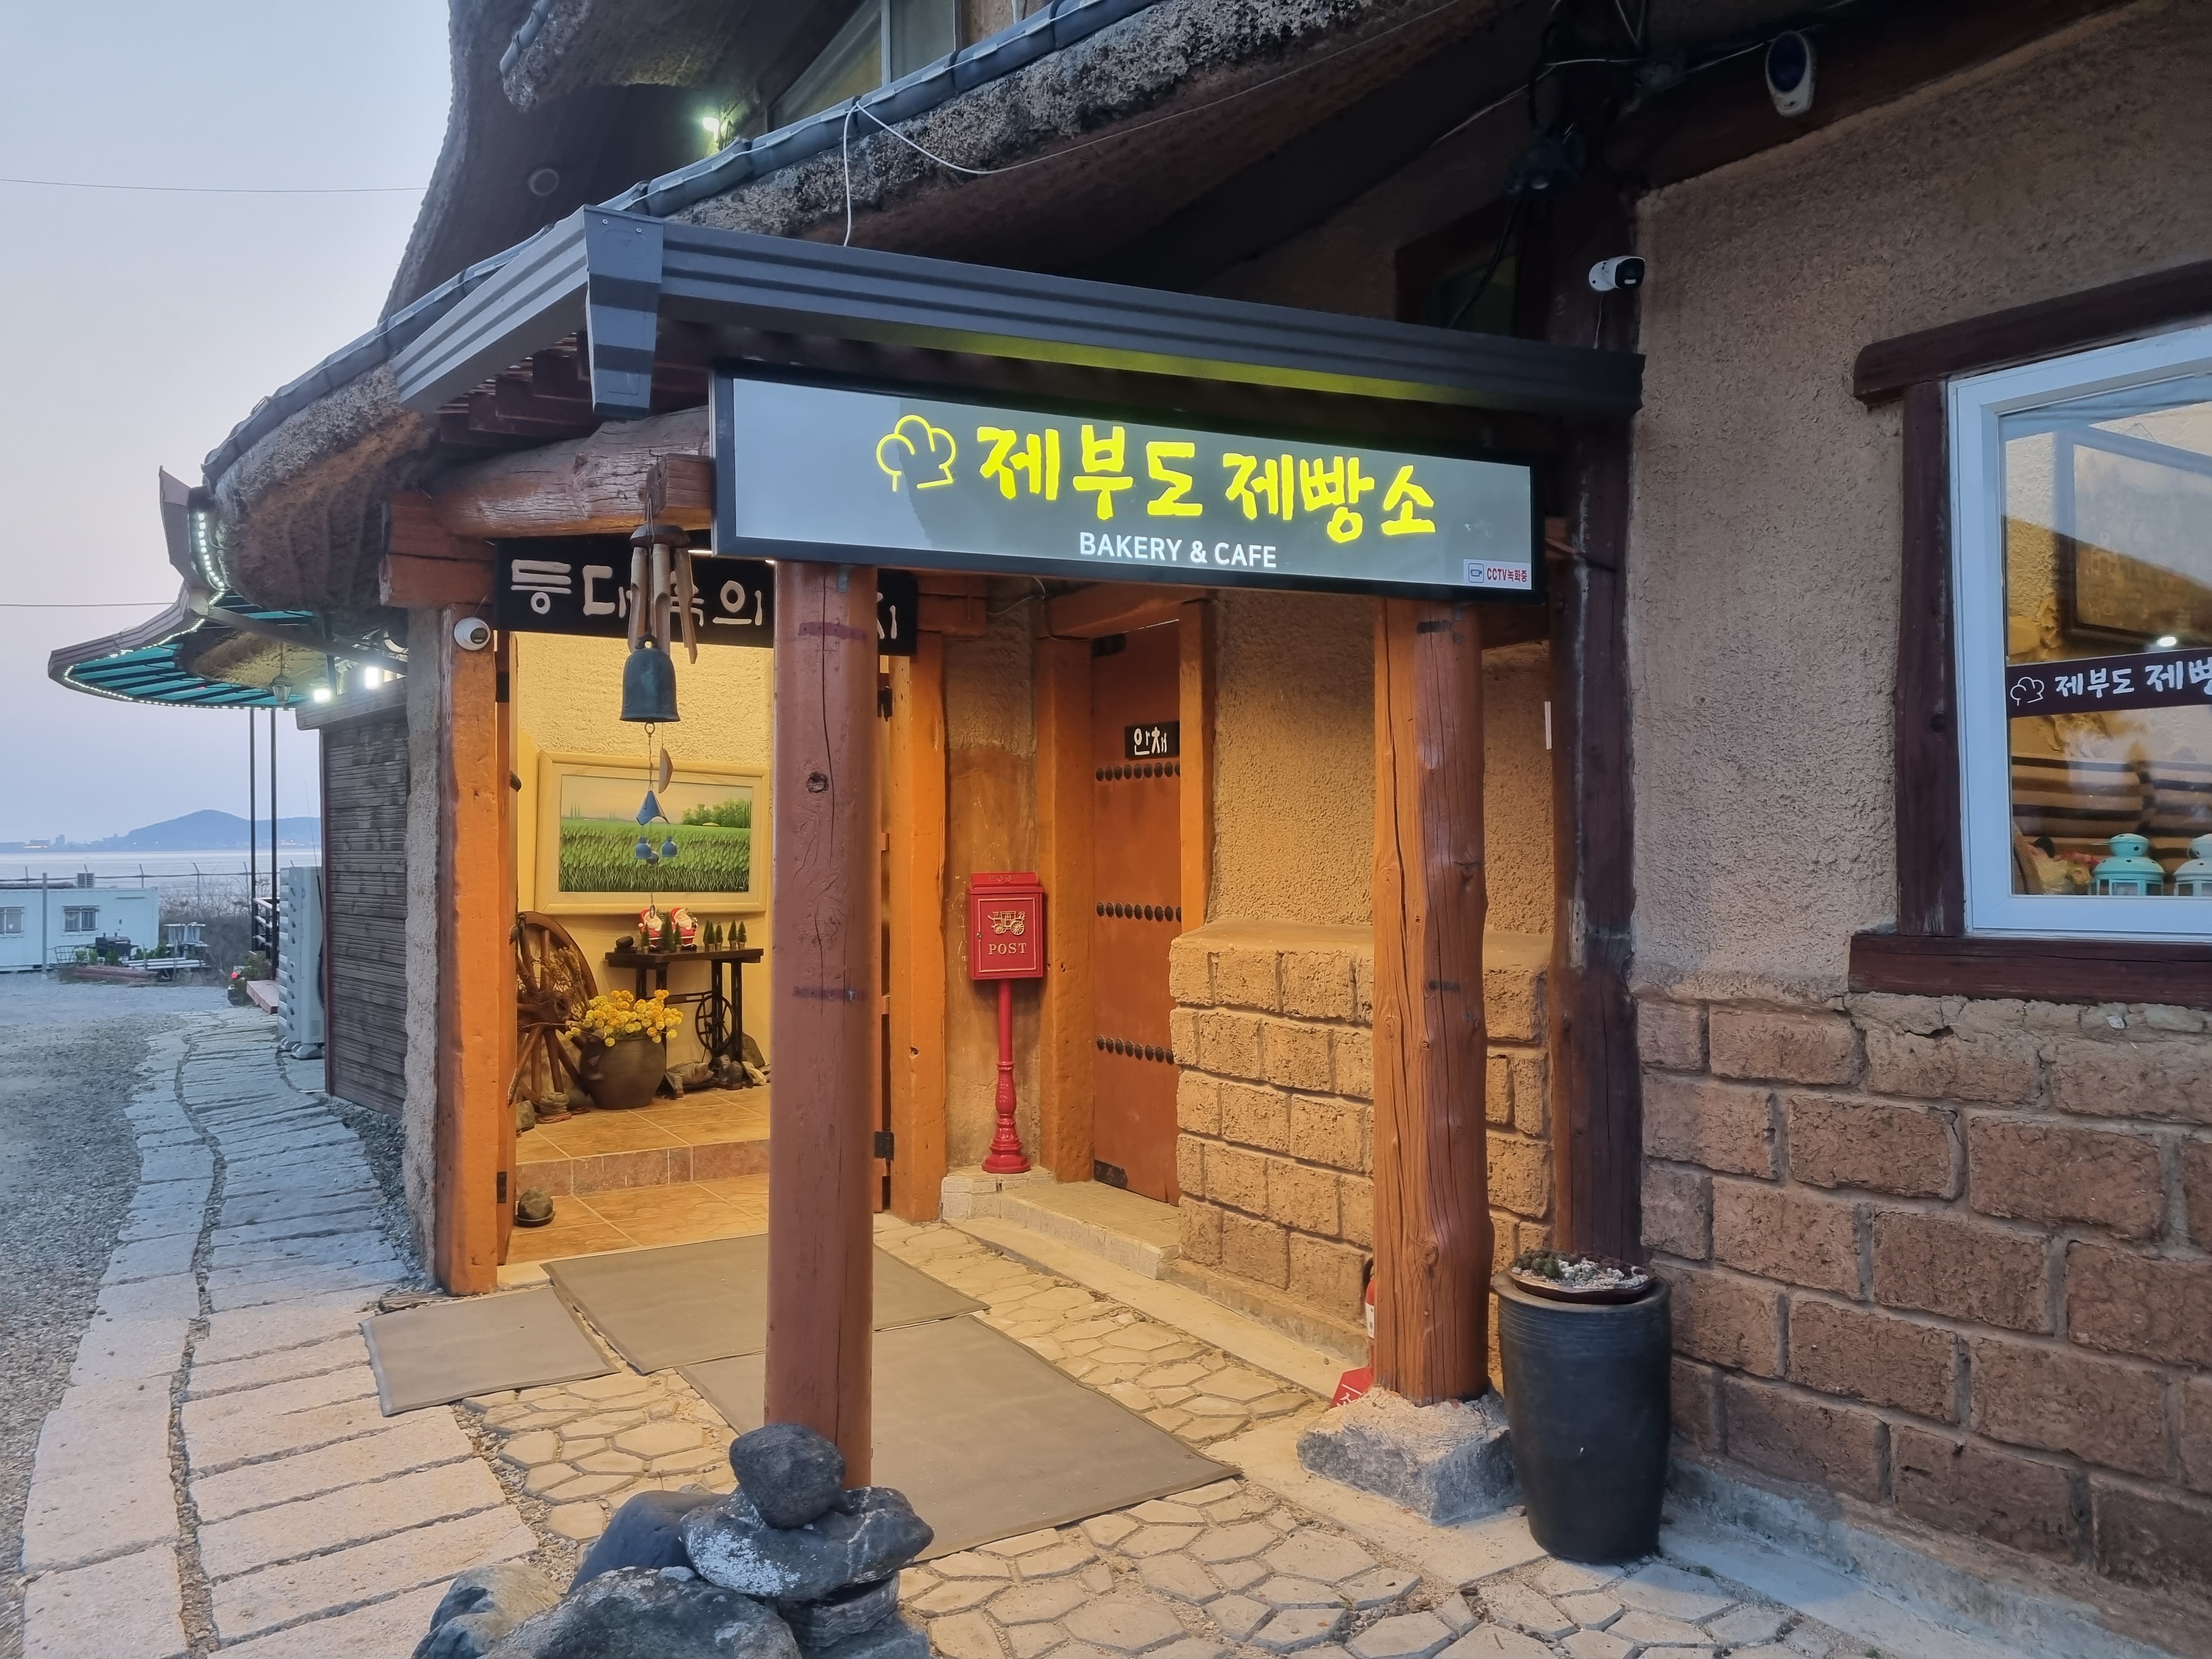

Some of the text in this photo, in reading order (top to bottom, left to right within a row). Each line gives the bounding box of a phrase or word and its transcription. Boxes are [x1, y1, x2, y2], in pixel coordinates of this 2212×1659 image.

[977, 424, 1436, 543] 제부도 제빵소
[1080, 531, 1277, 568] BAKERY & CAFE
[2055, 668, 2135, 698] 제부도
[1133, 726, 1167, 755] 안채
[988, 943, 1027, 956] POST
